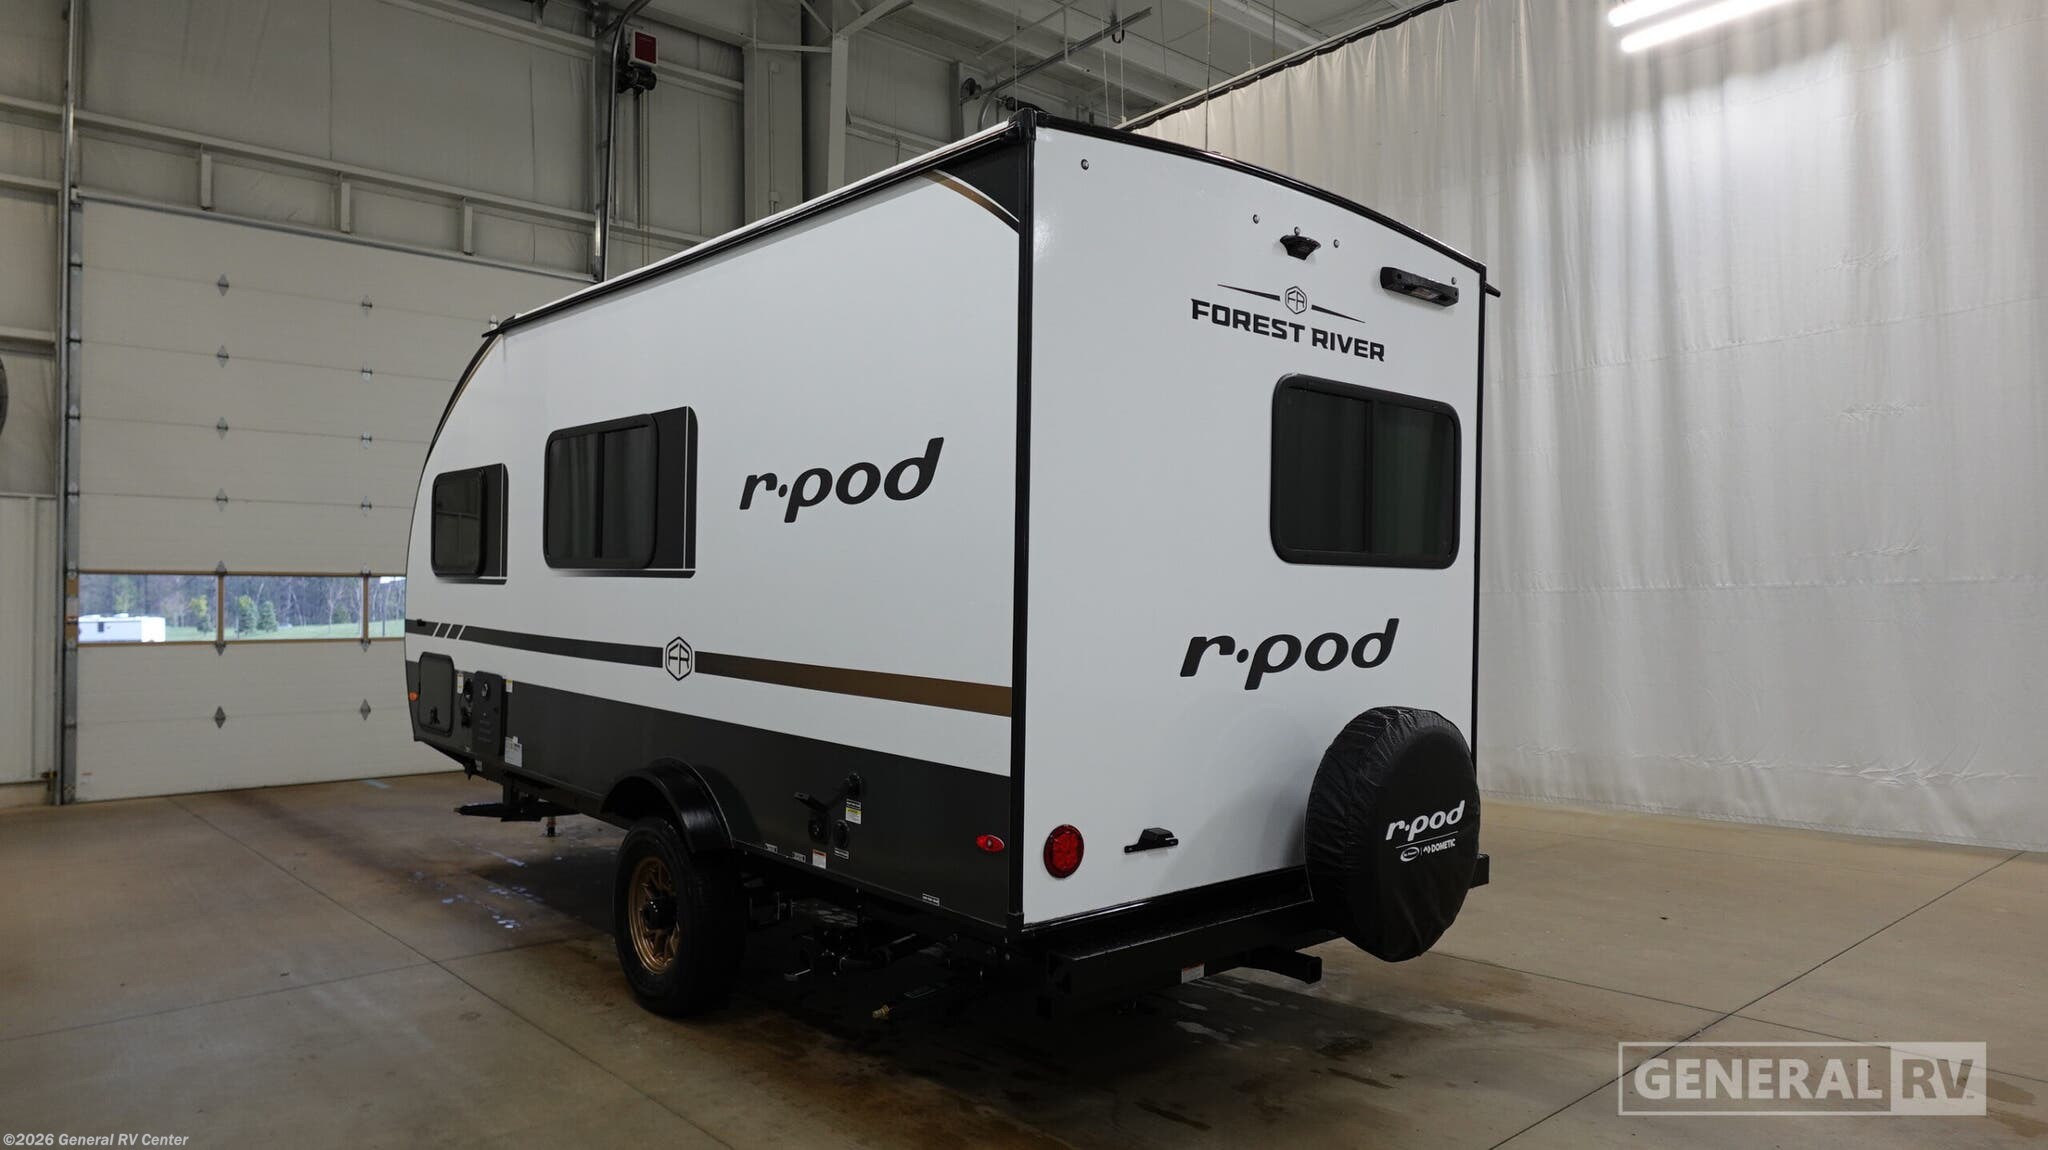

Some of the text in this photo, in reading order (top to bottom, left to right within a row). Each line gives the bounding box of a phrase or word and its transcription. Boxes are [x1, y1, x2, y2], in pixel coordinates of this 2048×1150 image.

[1191, 298, 1385, 362] FOREST RIVER
[1431, 838, 1456, 853] DOMETIC
